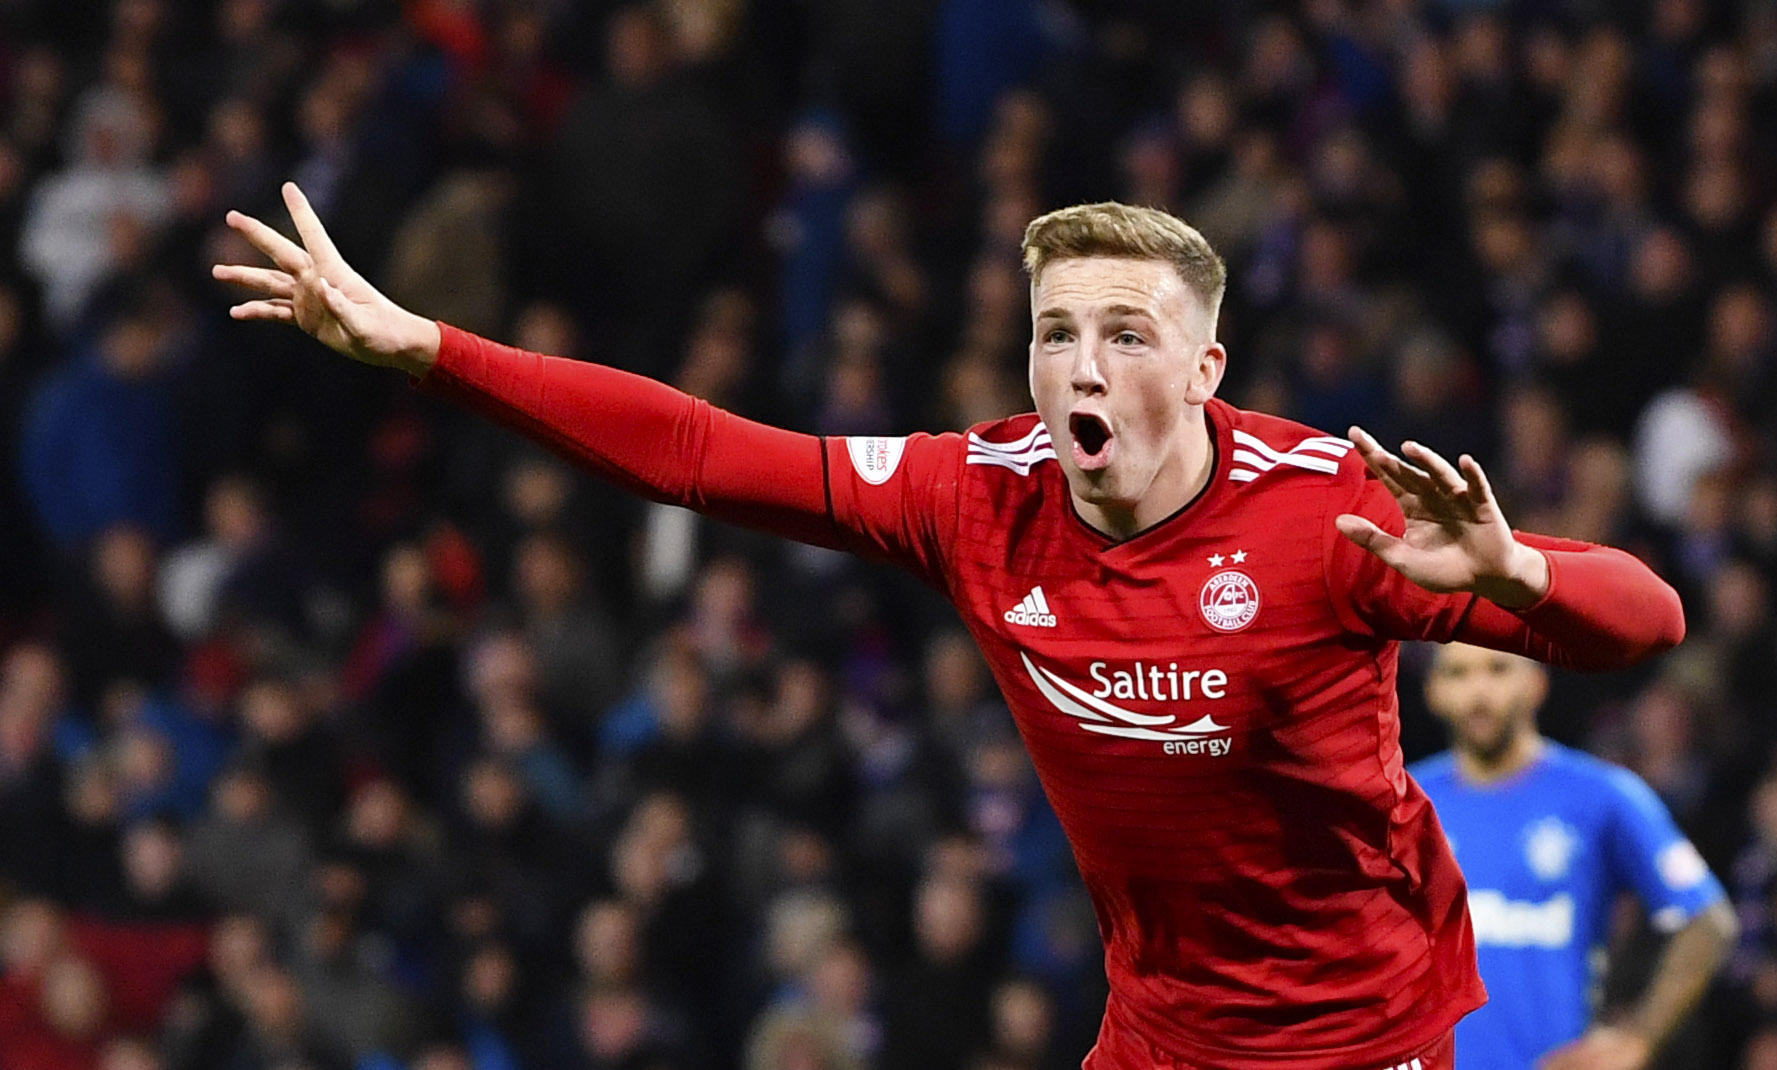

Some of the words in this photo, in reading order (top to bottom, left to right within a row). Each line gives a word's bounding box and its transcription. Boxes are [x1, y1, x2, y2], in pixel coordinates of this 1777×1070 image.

[1004, 609, 1058, 628] adidas
[1089, 661, 1228, 701] Saltire
[1163, 737, 1232, 756] energy
